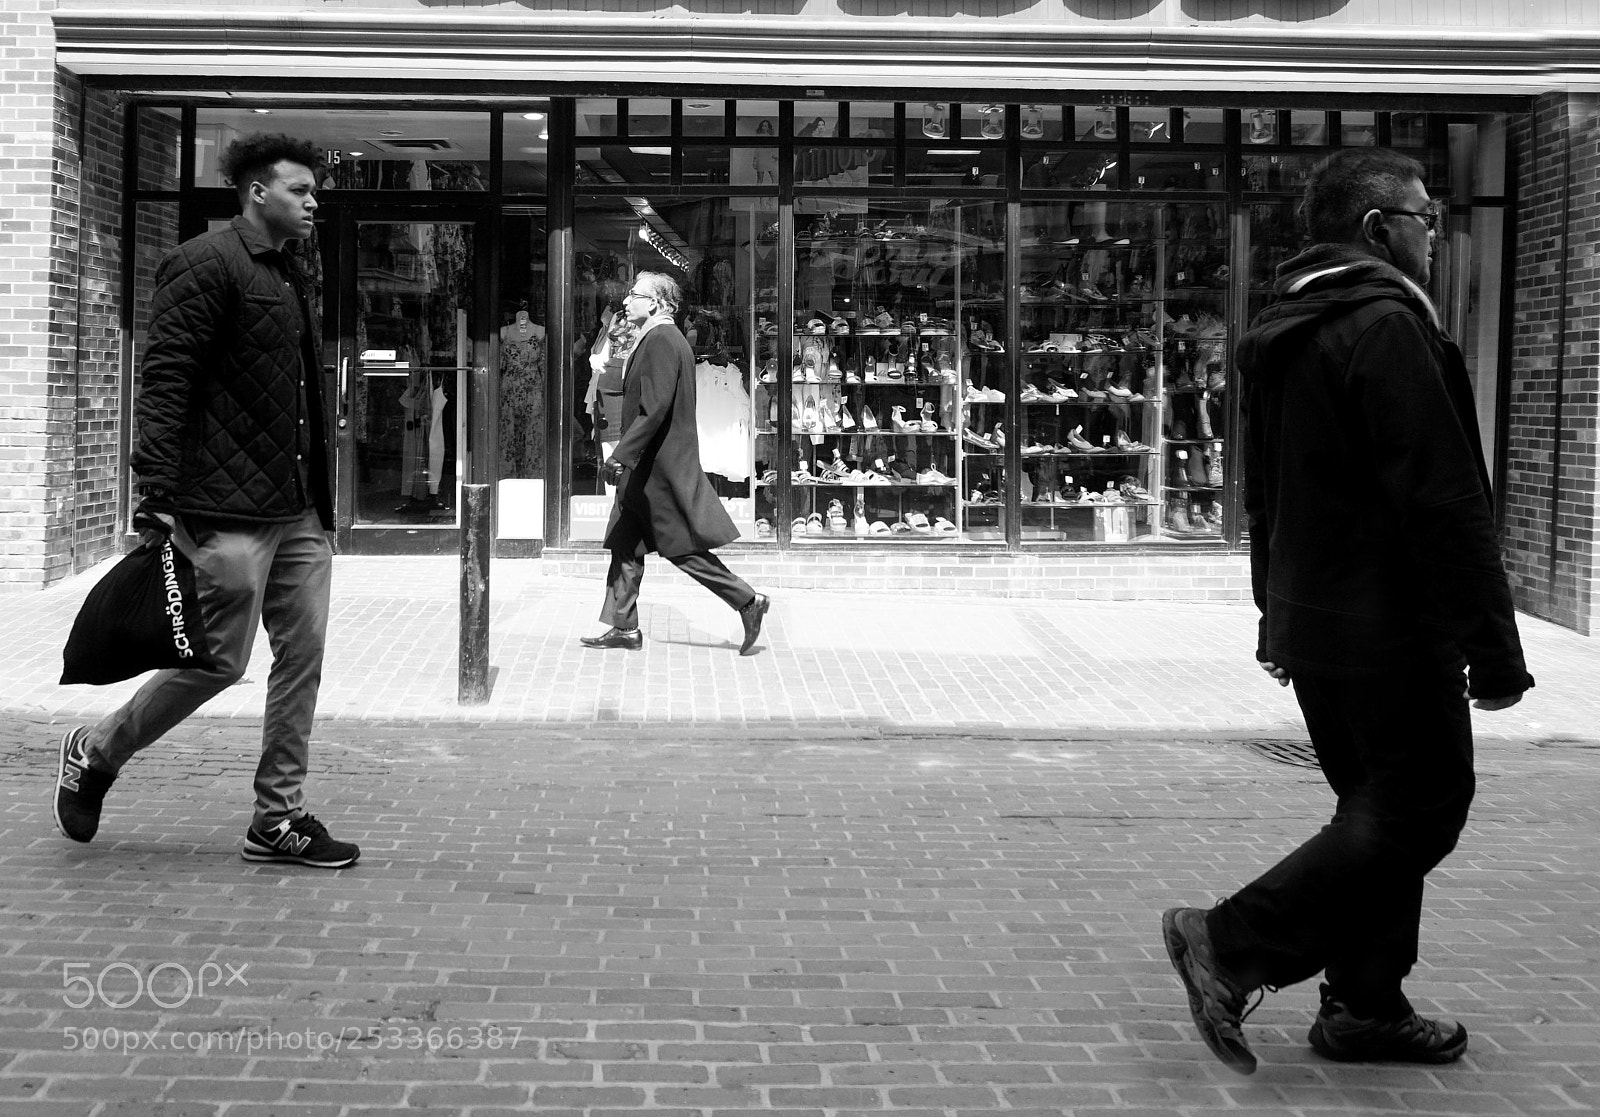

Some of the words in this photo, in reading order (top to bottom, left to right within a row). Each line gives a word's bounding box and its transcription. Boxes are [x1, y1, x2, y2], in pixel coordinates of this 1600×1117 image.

[327, 150, 341, 164] 15
[574, 502, 609, 516] VISIT
[61, 765, 81, 793] N
[279, 832, 312, 855] N
